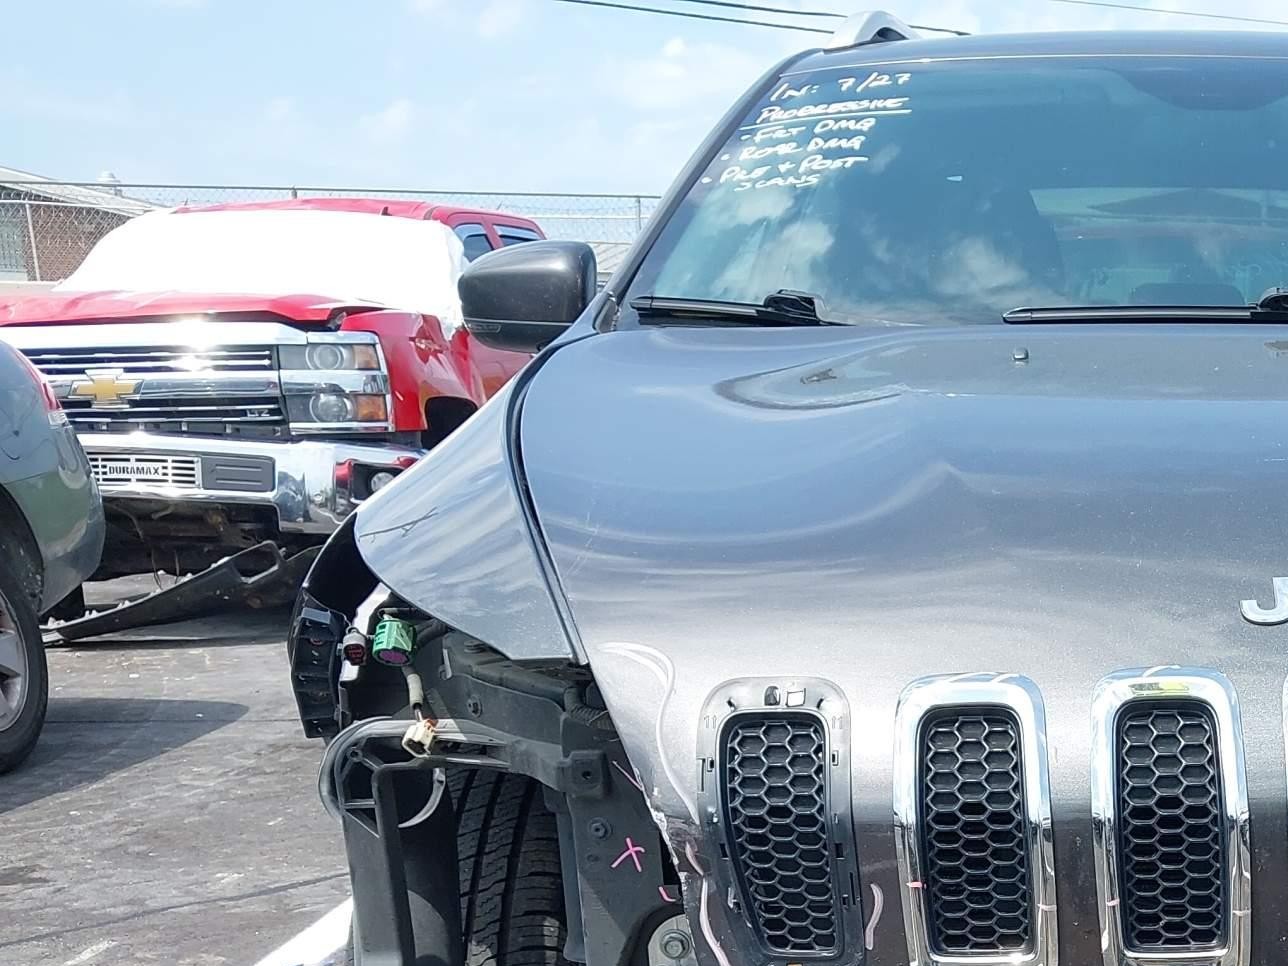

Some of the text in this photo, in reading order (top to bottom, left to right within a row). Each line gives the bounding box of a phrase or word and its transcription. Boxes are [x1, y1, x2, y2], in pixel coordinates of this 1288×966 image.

[838, 72, 912, 93] 7/27
[757, 97, 910, 123] PROGRESSIVE
[108, 464, 160, 477] DURAMAX
